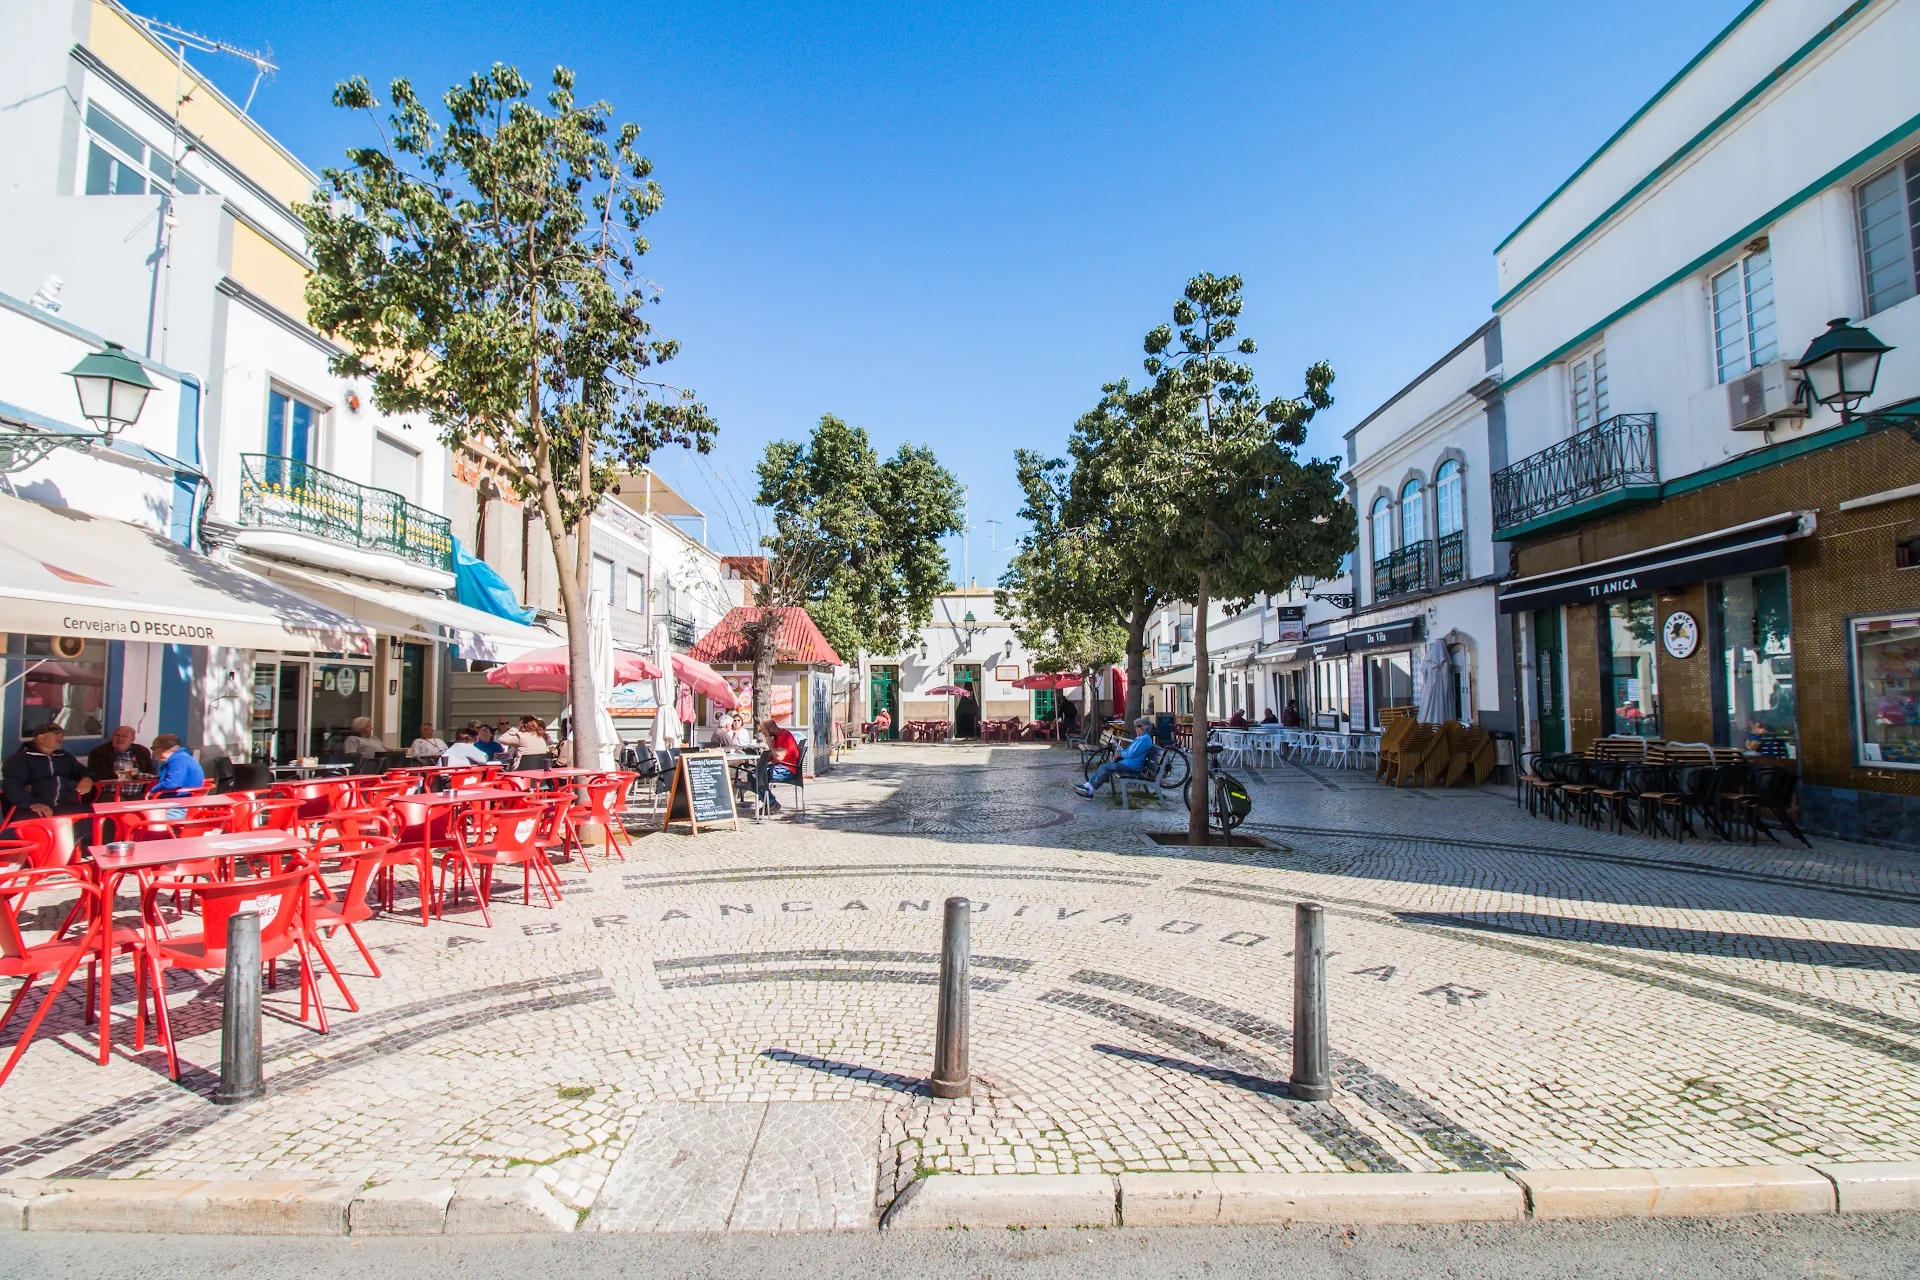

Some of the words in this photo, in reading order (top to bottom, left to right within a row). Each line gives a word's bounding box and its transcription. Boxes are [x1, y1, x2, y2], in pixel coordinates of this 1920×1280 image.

[1589, 585, 1599, 597] TI
[1603, 578, 1638, 594] ANICA
[63, 617, 127, 633] Cervejaria
[130, 620, 141, 634] O
[145, 621, 215, 640] PESCADOR
[1673, 614, 1694, 628] ANICA
